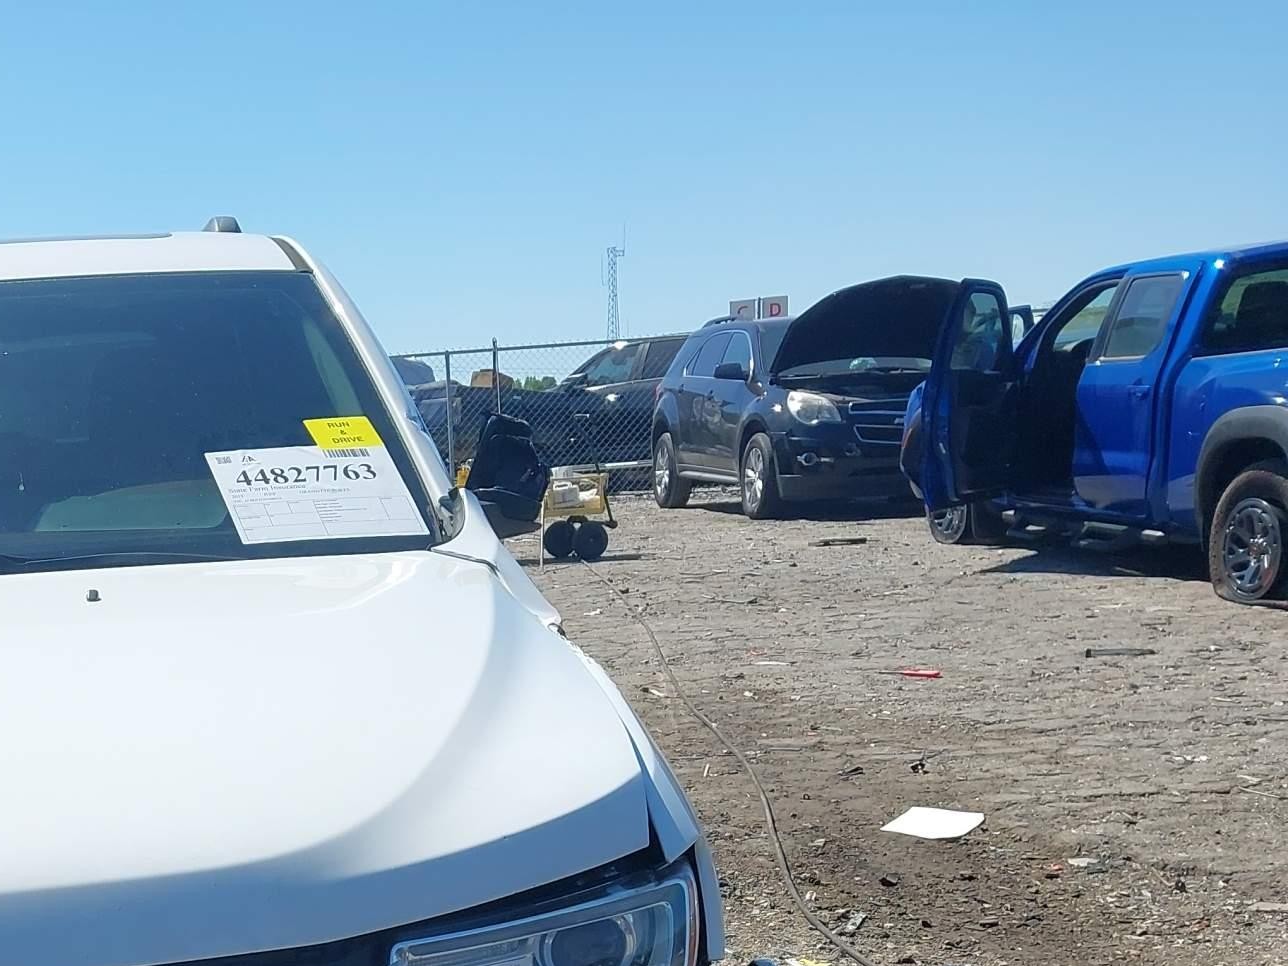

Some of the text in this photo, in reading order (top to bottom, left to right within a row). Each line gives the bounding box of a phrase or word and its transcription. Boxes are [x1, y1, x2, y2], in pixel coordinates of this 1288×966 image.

[769, 303, 782, 317] D
[332, 436, 365, 444] DRIVE
[236, 463, 377, 486] 44827763
